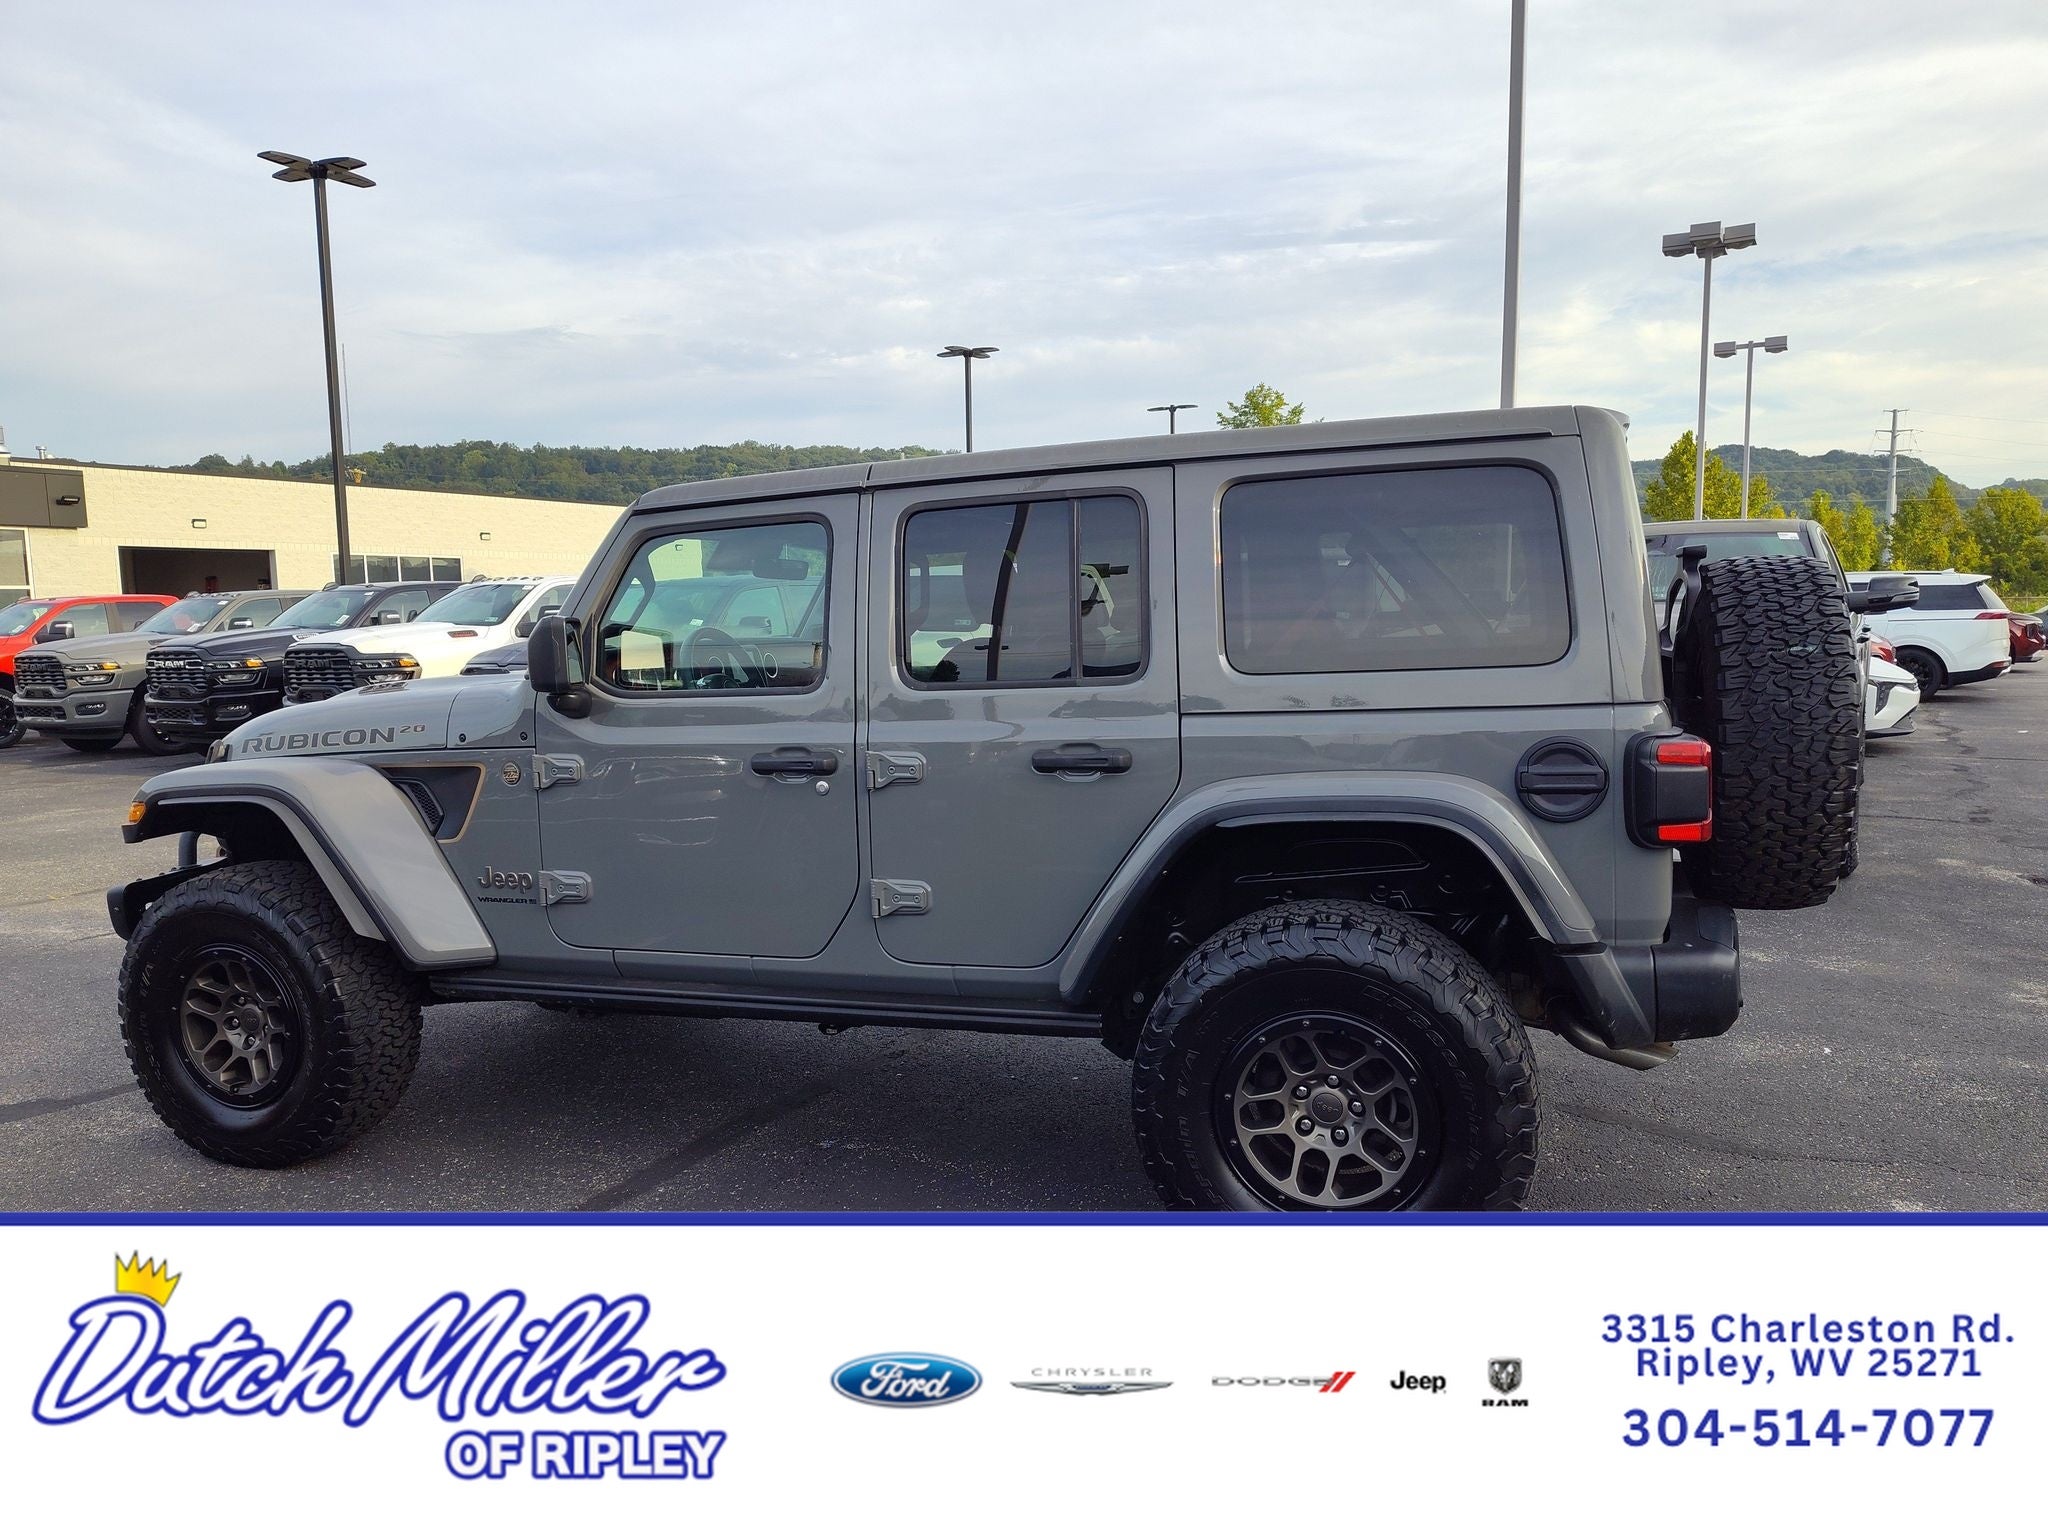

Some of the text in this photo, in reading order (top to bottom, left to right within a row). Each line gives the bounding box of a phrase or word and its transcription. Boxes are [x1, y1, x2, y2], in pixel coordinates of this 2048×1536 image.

[153, 660, 186, 669] RAM
[294, 658, 333, 669] RAM
[240, 724, 426, 754] RUBICON 20
[477, 865, 533, 895] Jeep
[477, 896, 528, 905] WRANGLER
